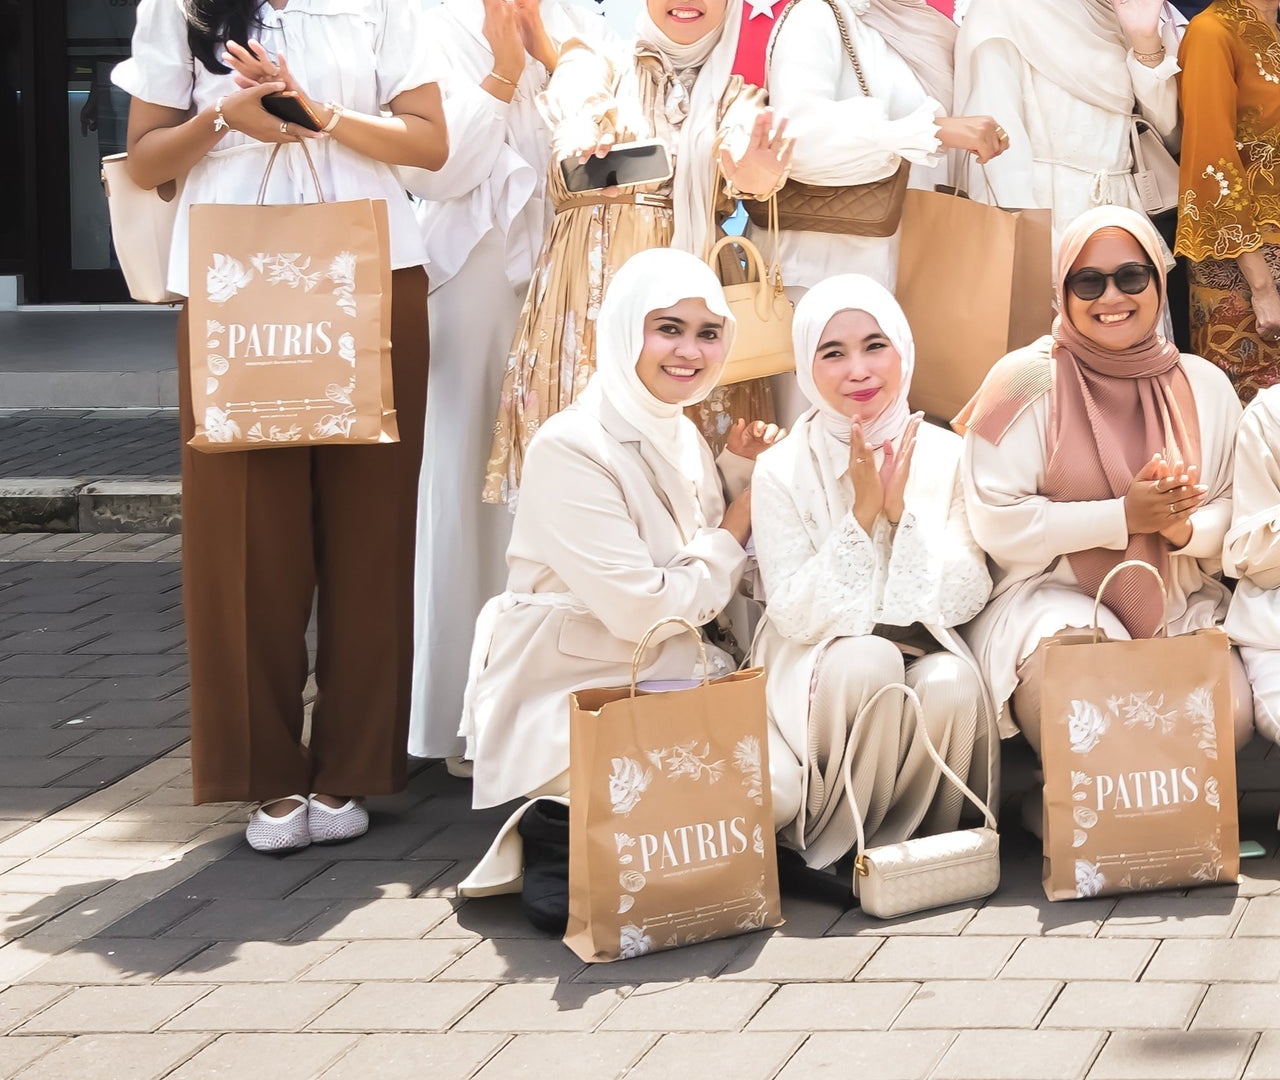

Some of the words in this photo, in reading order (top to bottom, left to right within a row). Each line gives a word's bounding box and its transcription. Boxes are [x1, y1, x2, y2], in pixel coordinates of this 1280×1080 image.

[228, 321, 332, 359] PATRIS
[1096, 766, 1200, 811] PATRIS
[638, 816, 749, 873] PATRIS
